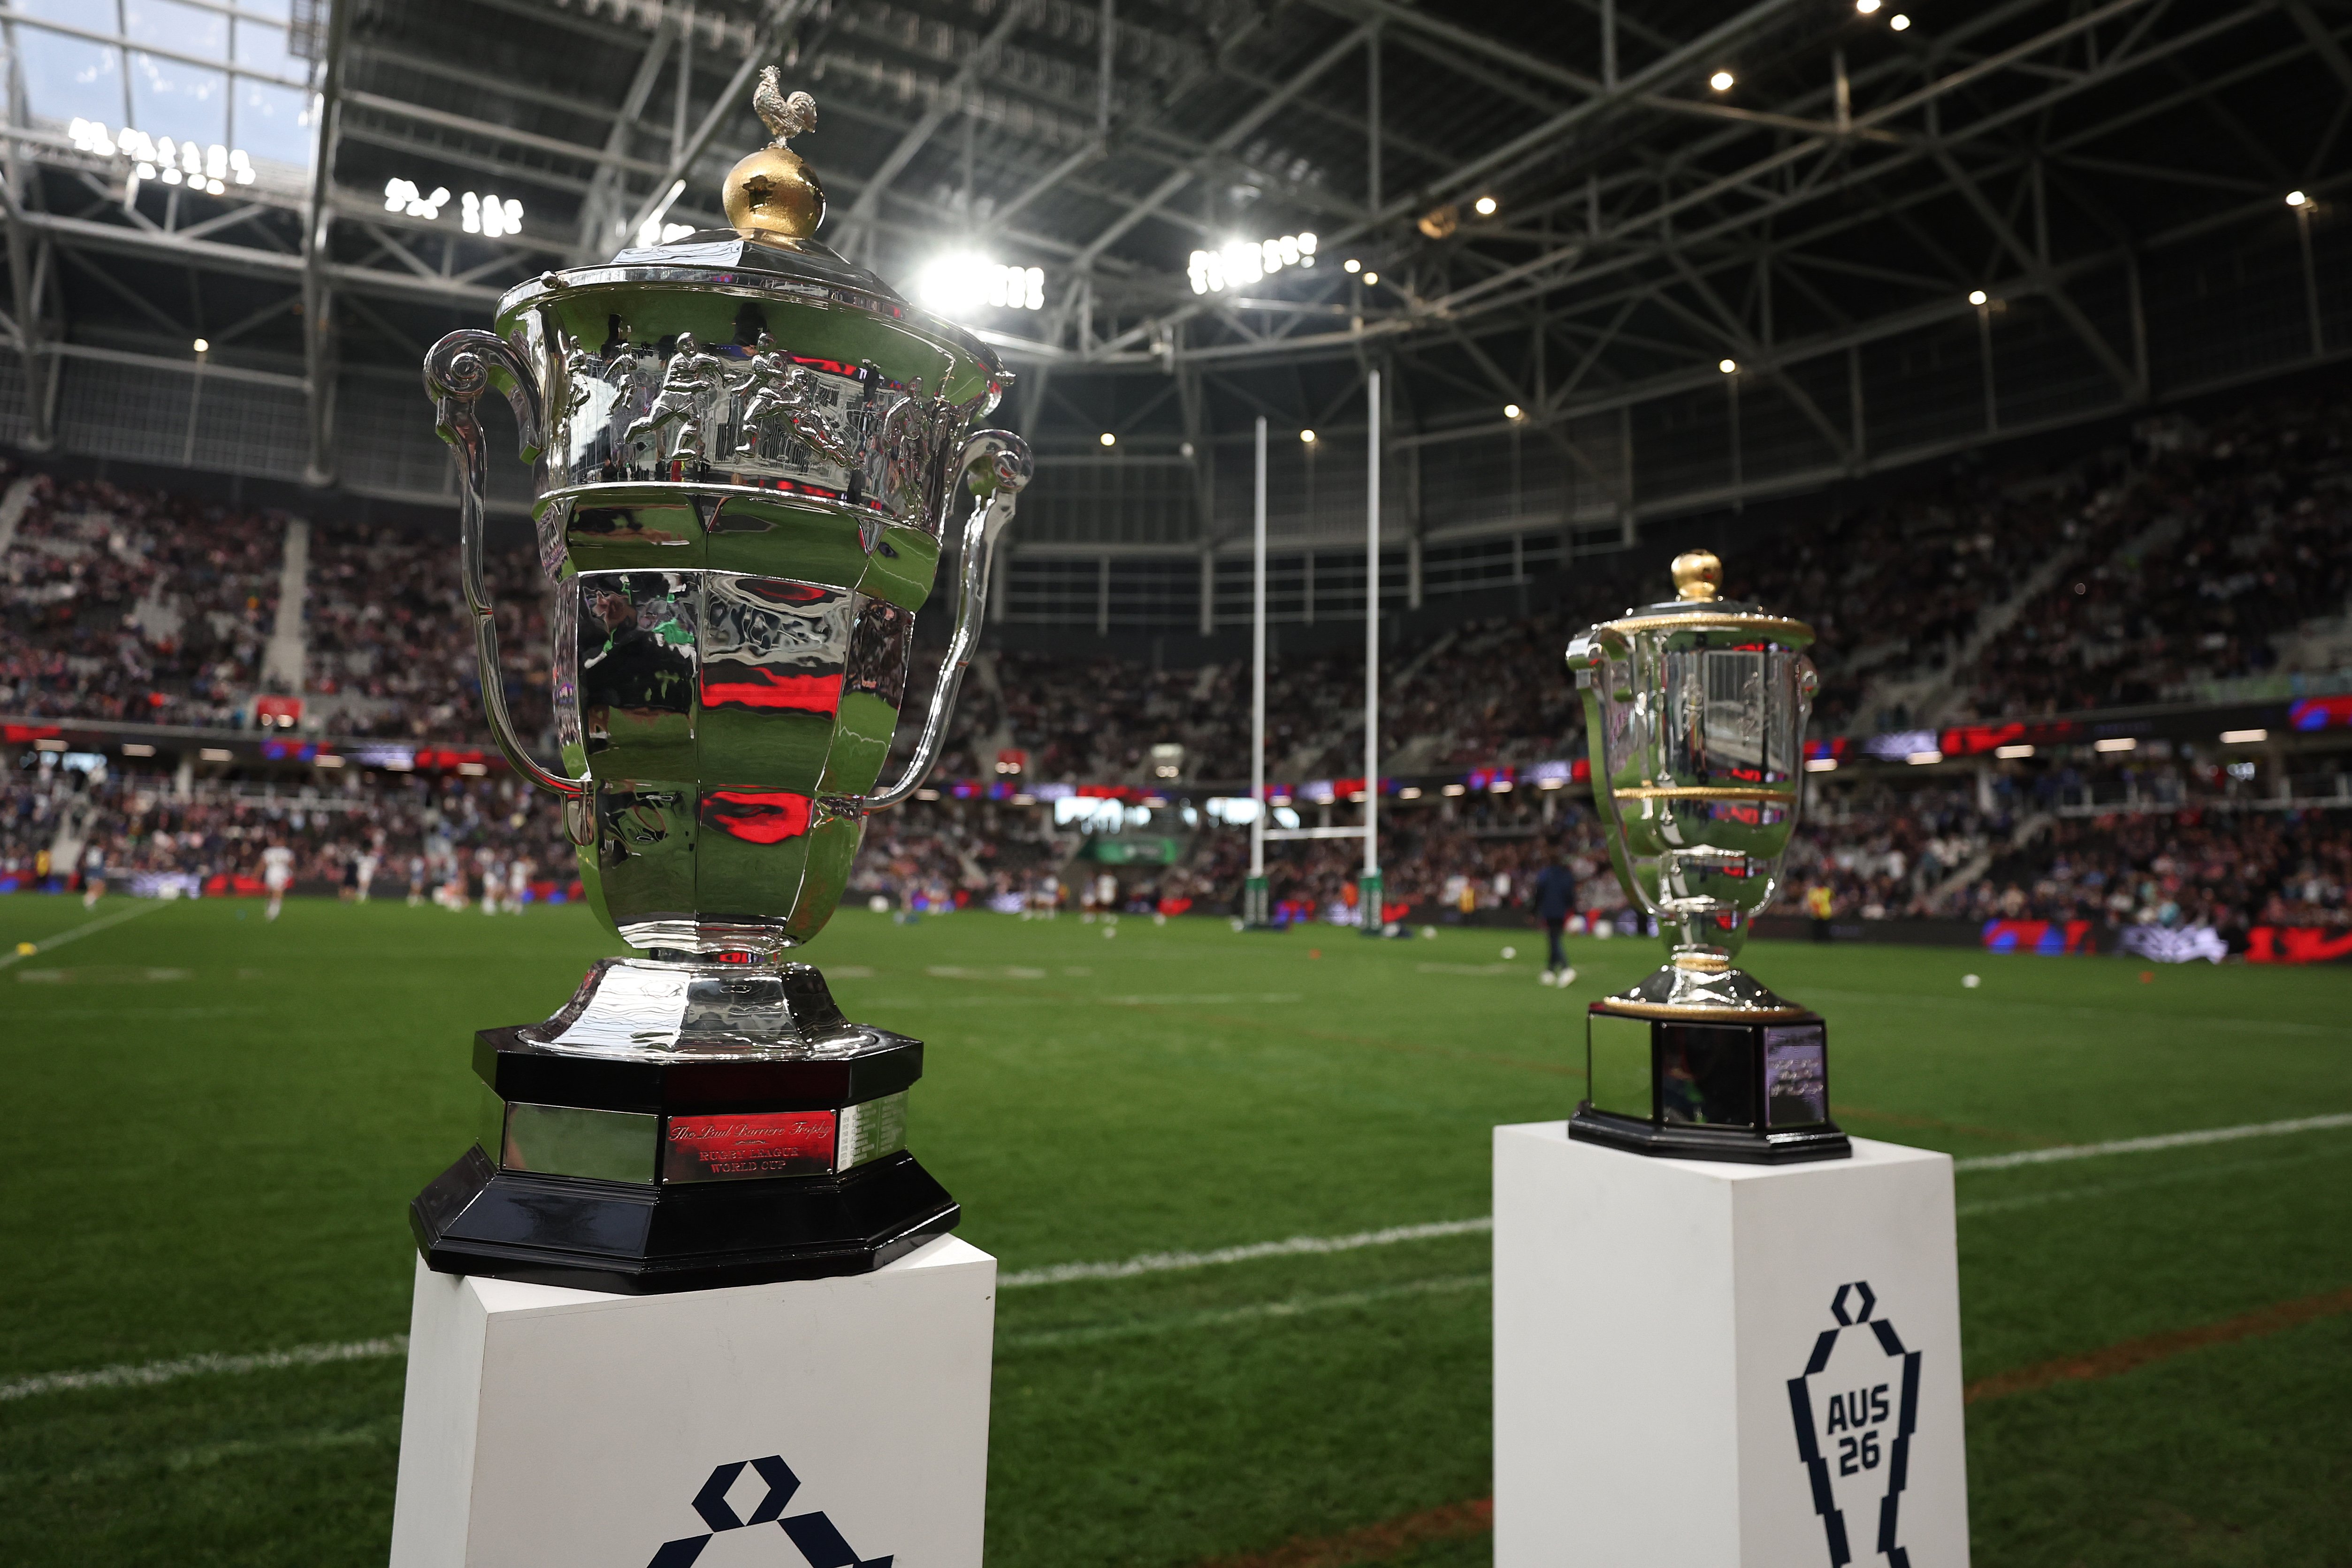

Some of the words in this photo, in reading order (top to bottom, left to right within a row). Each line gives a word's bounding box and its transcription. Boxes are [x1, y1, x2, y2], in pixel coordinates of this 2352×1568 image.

[669, 1126, 696, 1141] The
[696, 1124, 733, 1140] Paul
[789, 1121, 833, 1140] Trophy
[699, 1150, 746, 1161] RUGBY
[749, 1147, 799, 1158] LEAGUE
[710, 1162, 756, 1173] WORLD
[760, 1160, 787, 1170] CUP
[1828, 1384, 1889, 1435] AUS
[1839, 1430, 1880, 1476] 26
